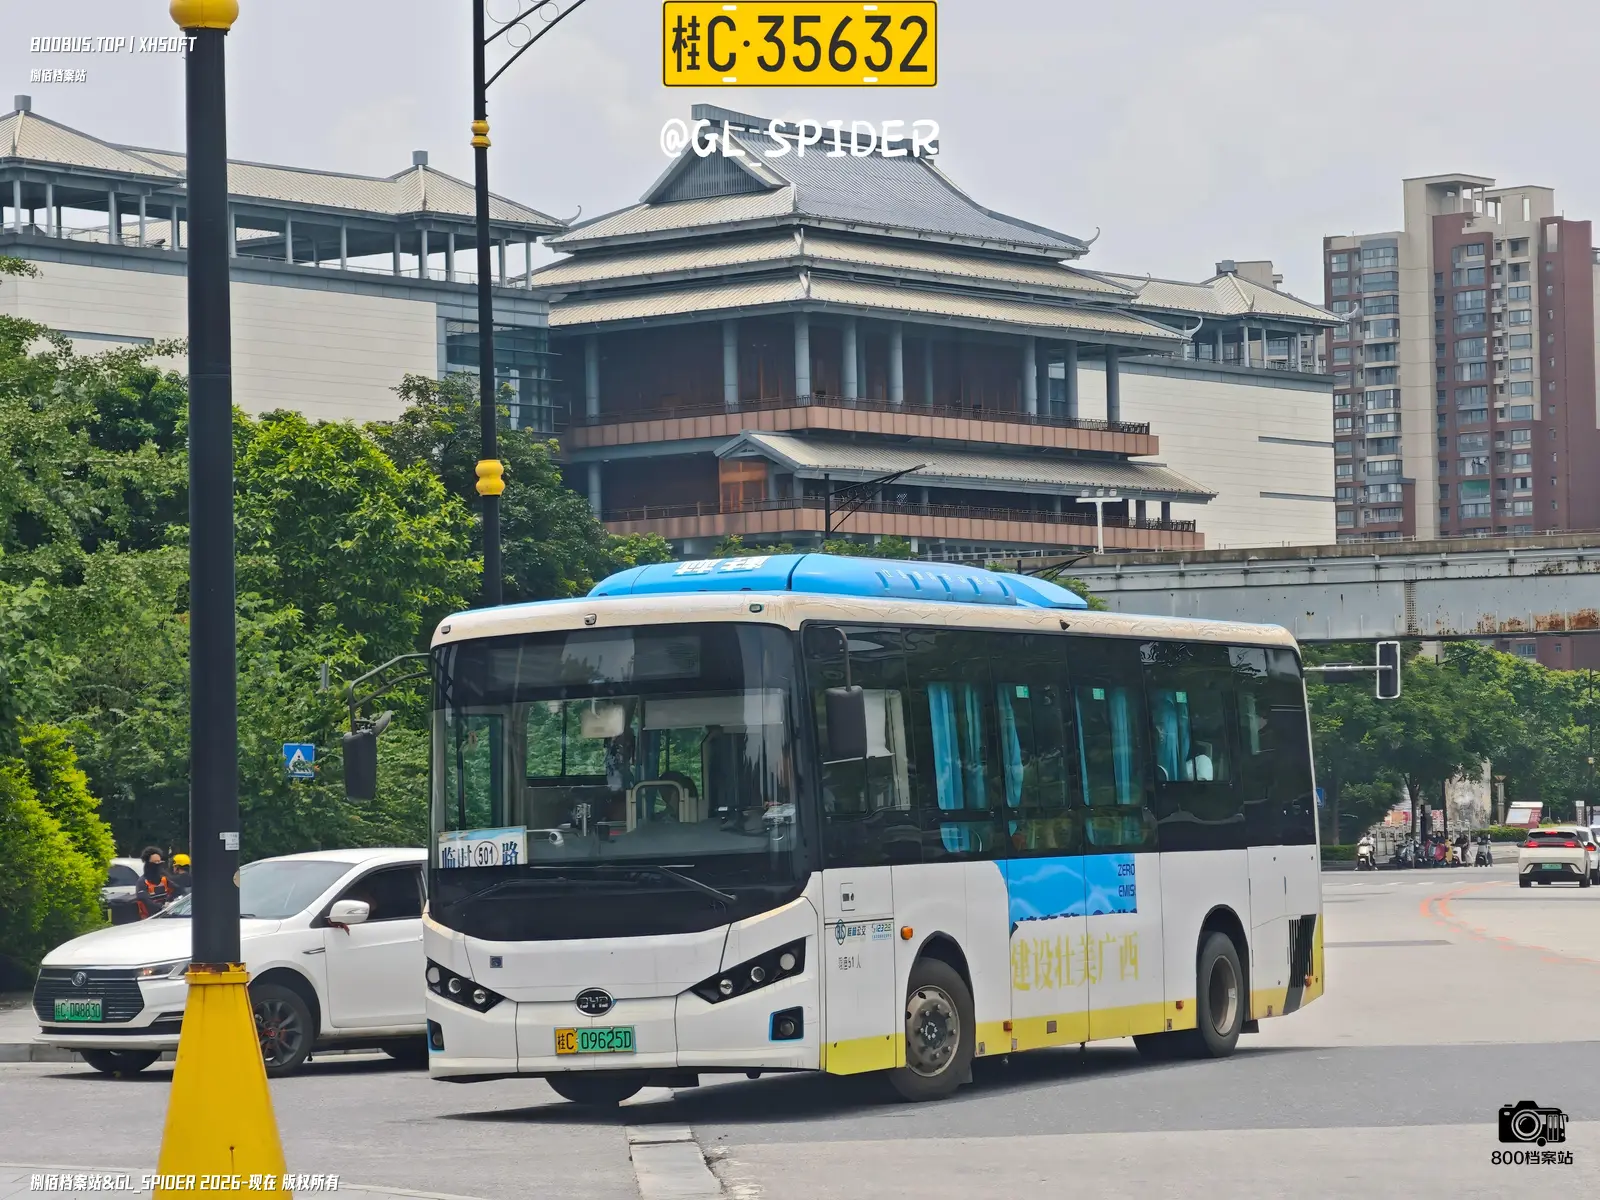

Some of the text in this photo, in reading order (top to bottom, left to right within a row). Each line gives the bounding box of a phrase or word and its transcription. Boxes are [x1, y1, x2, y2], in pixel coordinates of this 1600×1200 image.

[1118, 884, 1136, 898] EMIS
[1011, 931, 1138, 992] 建设壮美广西
